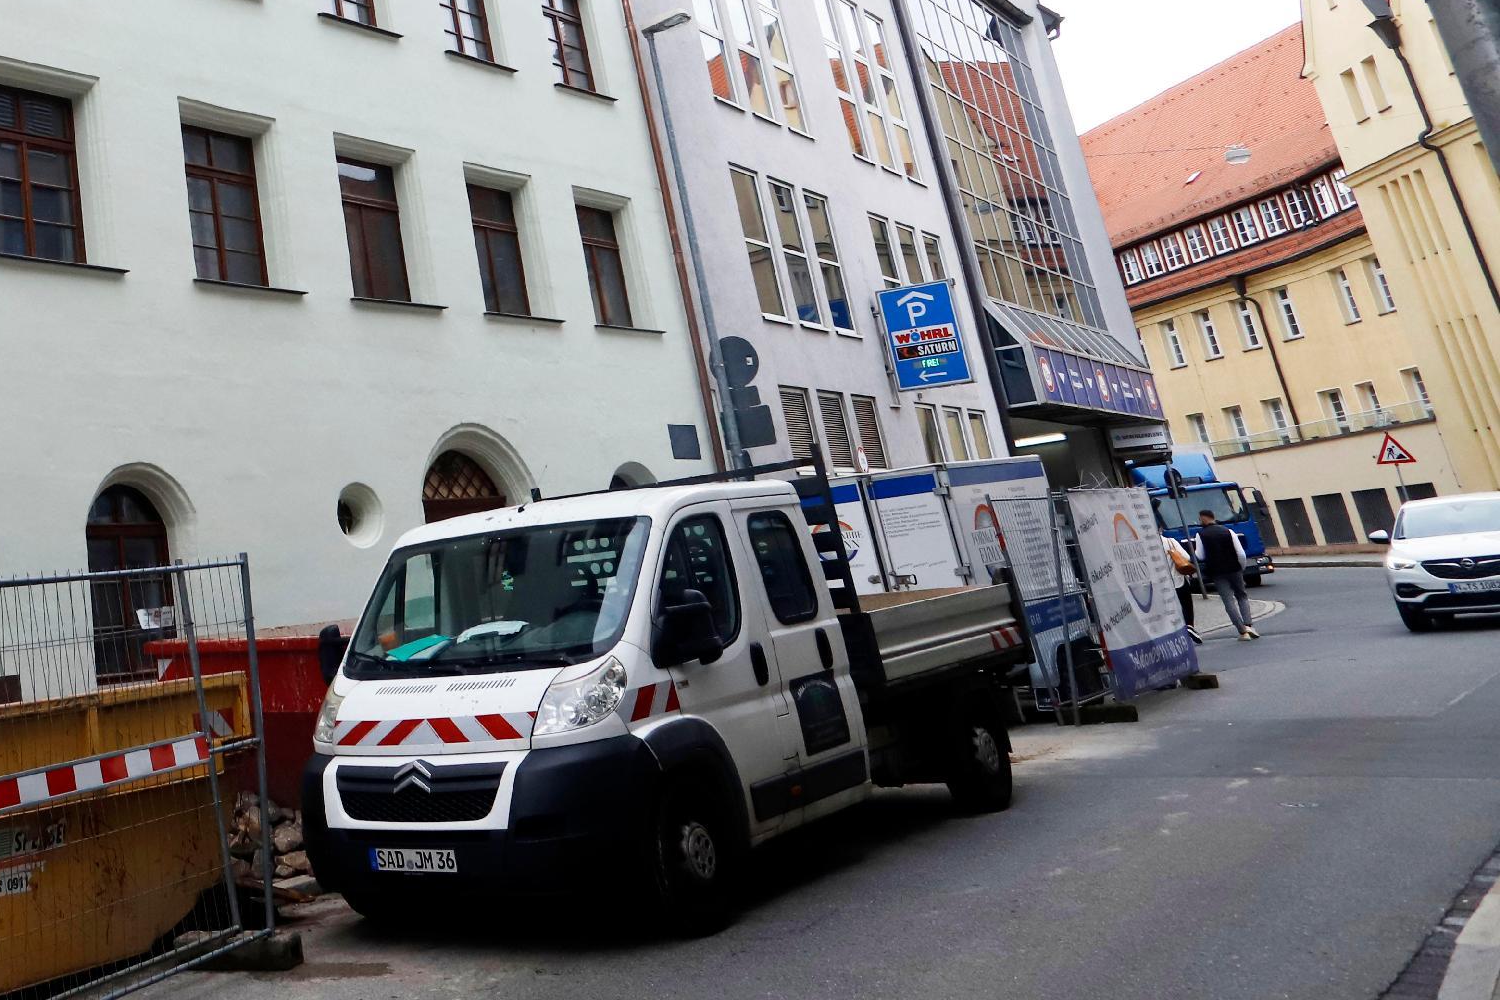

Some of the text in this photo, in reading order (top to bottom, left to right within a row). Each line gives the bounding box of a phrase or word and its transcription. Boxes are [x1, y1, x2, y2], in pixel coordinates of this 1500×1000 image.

[907, 302, 926, 327] P
[895, 327, 953, 344] WÖHRL
[917, 340, 957, 356] SATURN
[921, 358, 940, 368] FREI
[377, 850, 455, 869] SAD JM 36
